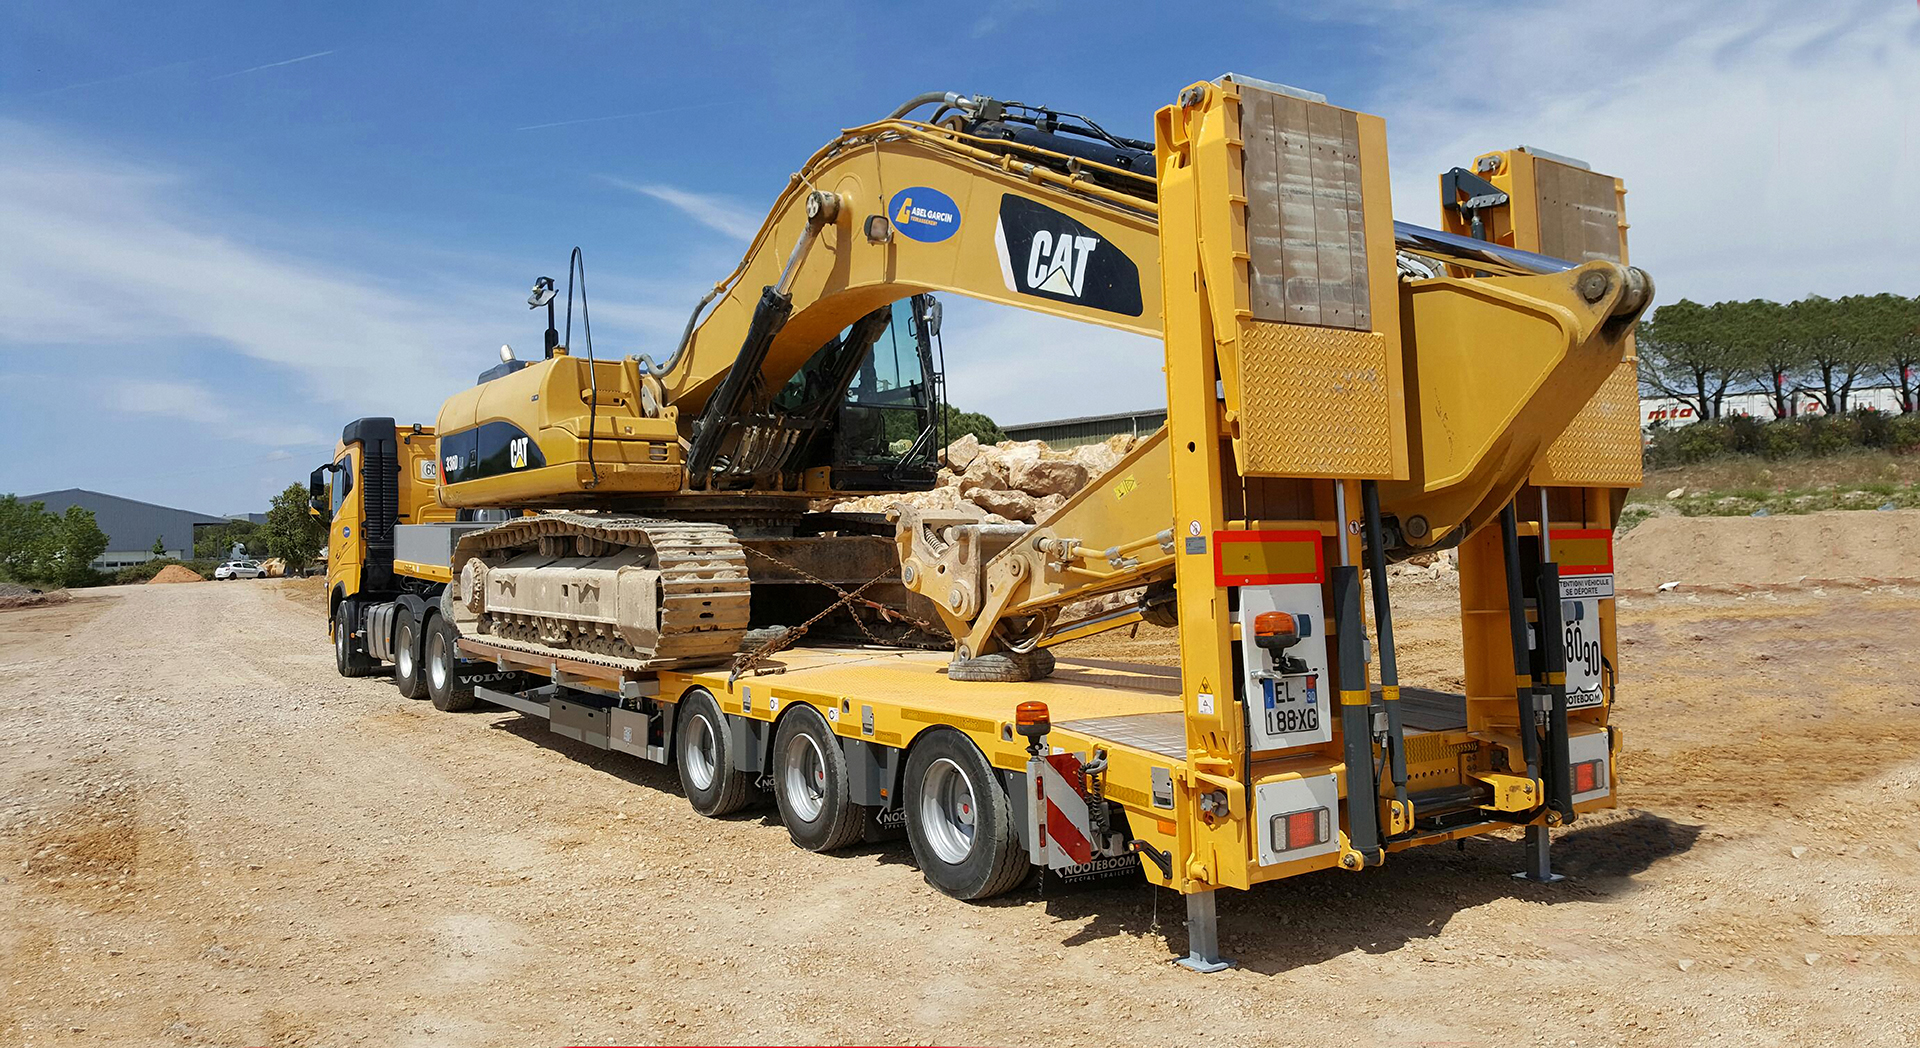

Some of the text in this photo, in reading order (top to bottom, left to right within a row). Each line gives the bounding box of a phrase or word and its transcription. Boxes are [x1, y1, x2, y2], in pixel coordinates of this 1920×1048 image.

[911, 207, 953, 223] ABEL GARCIN
[1027, 230, 1097, 298] CAT
[1648, 408, 1693, 420] mta
[510, 437, 528, 469] CAT
[1565, 588, 1573, 597] SE
[1565, 627, 1582, 663] 80
[1583, 641, 1599, 677] 90
[458, 672, 516, 684] VOLVO
[1567, 693, 1600, 705] OTEBOOM
[1065, 855, 1135, 875] NOOTEBOOM
[1064, 868, 1135, 884] SPECIAL TRAILERS
